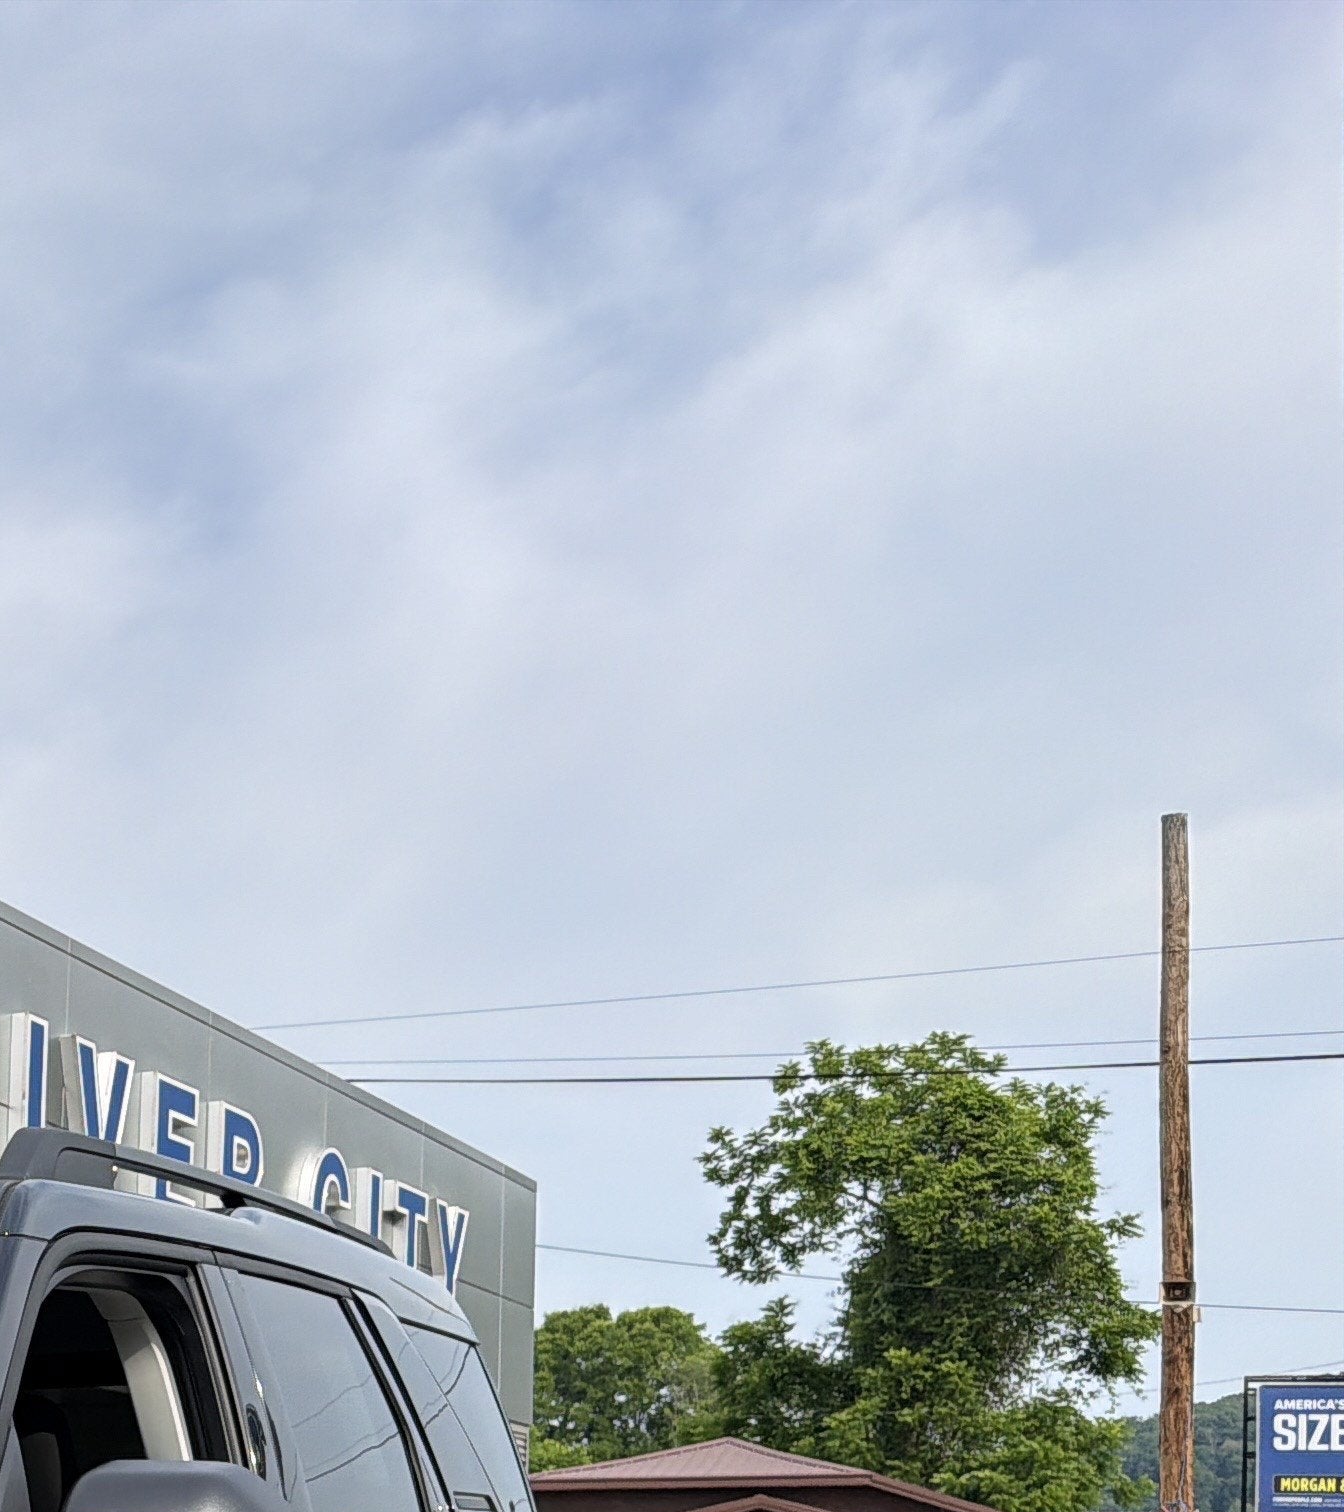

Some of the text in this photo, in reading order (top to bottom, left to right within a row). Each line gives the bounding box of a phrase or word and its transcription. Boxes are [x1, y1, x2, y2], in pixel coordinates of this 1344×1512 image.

[1274, 1398, 1344, 1411] AMERICA'S
[1273, 1413, 1344, 1451] SIZE
[1280, 1477, 1337, 1492] MORGAN
